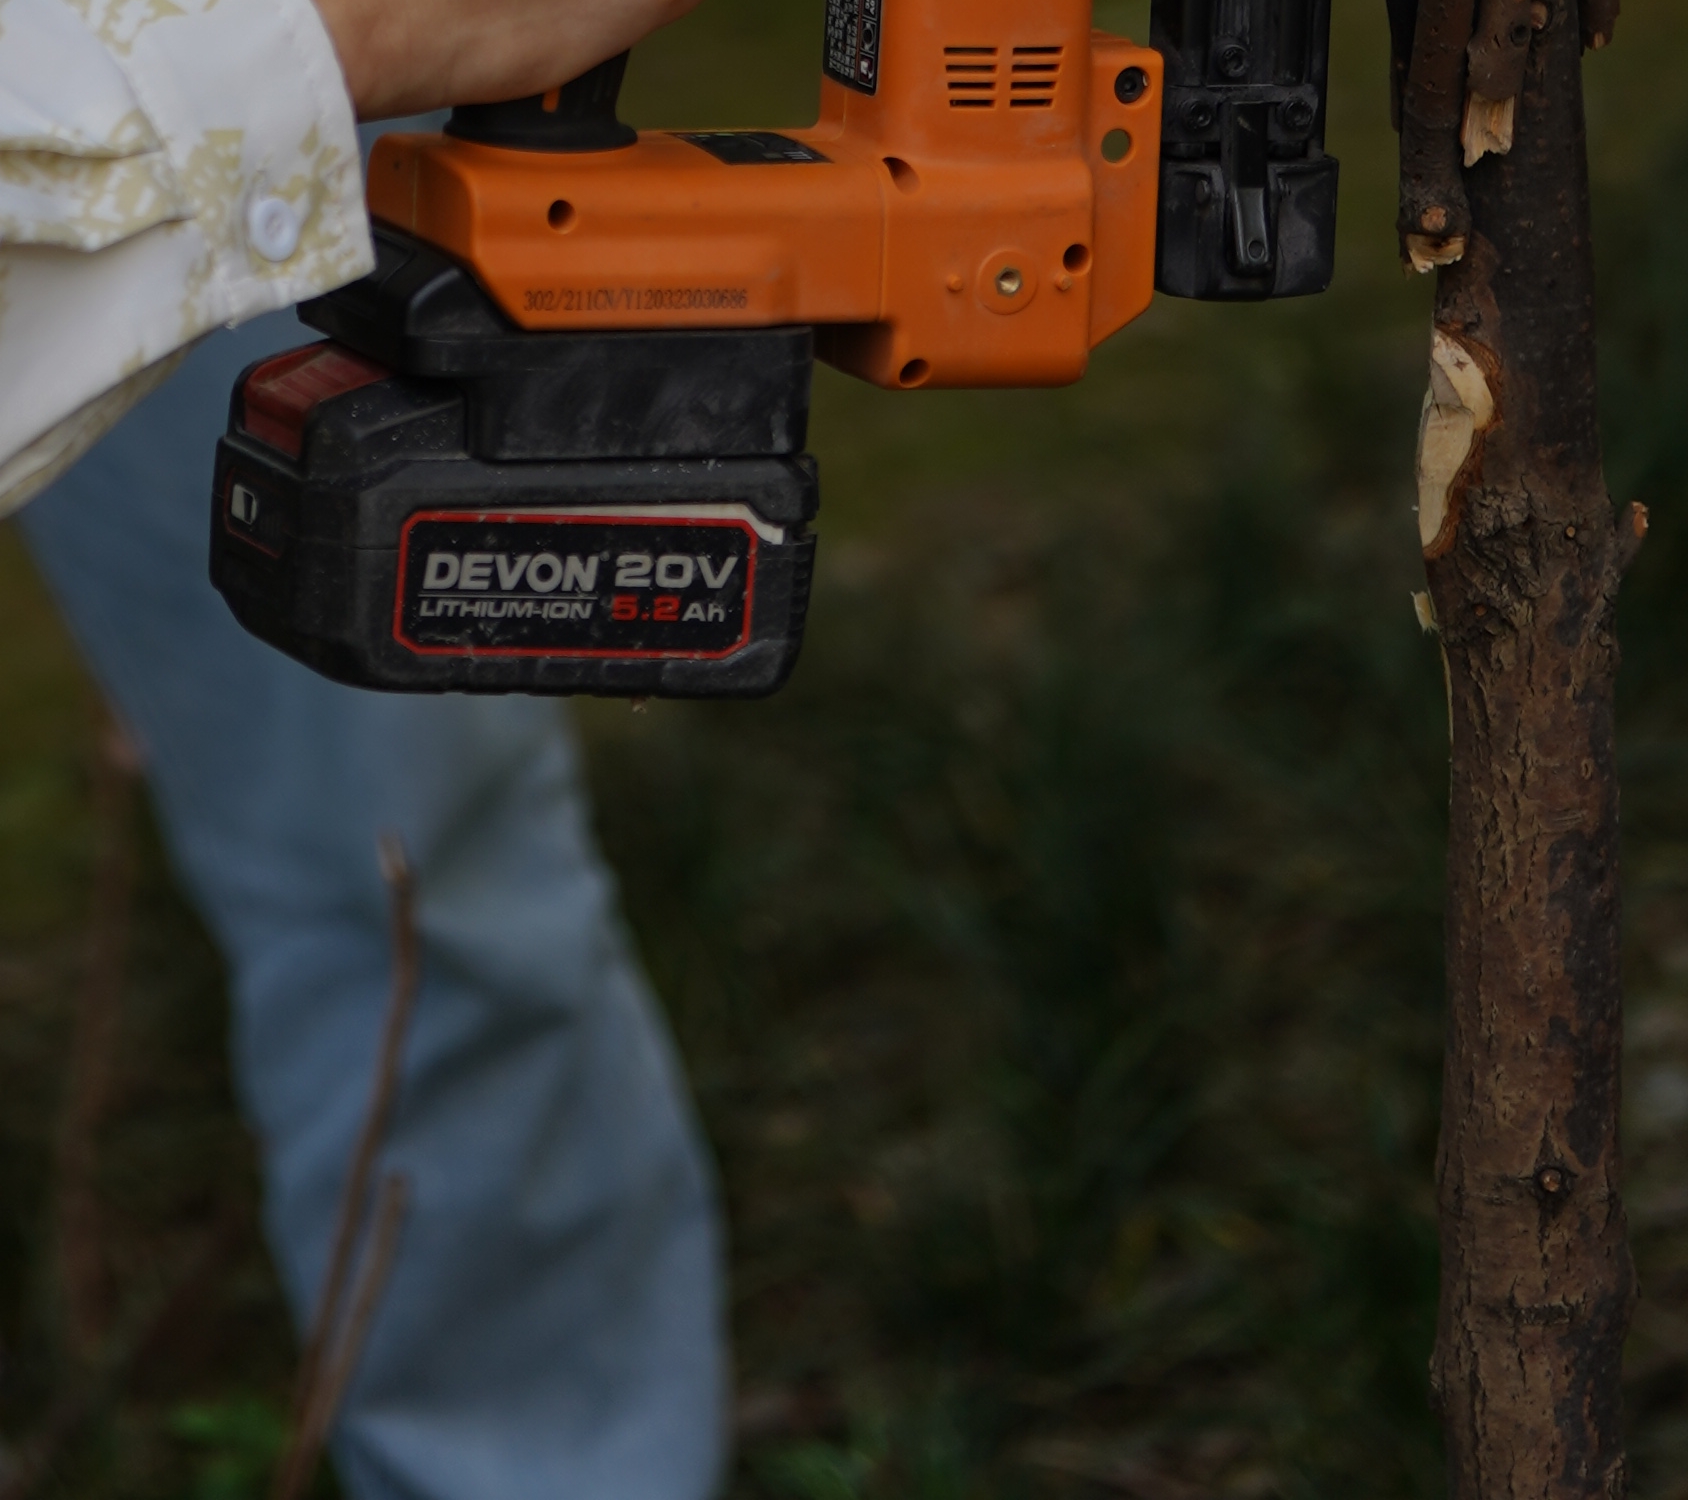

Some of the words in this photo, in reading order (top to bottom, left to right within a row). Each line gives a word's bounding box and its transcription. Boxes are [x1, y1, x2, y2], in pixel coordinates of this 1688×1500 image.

[422, 551, 600, 593] DEVON
[613, 552, 741, 589] 20V
[418, 598, 594, 621] LITHIUM-ION
